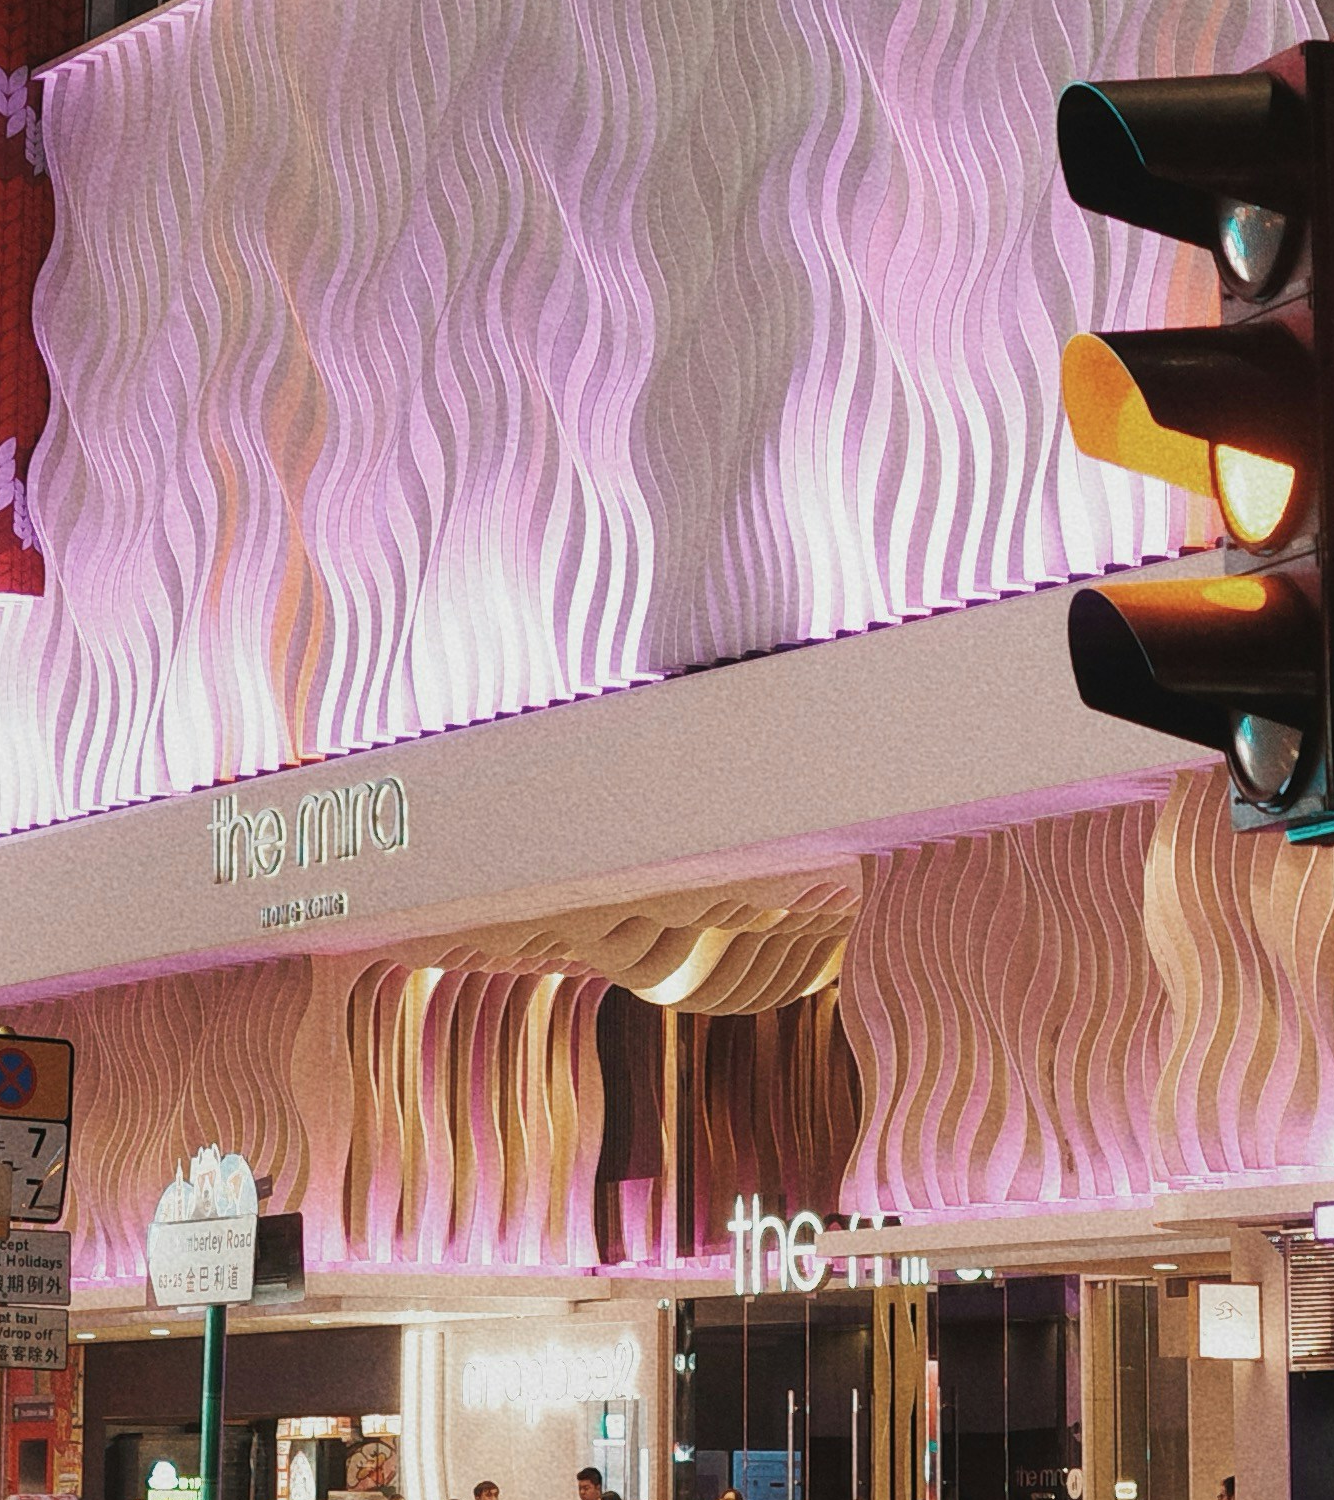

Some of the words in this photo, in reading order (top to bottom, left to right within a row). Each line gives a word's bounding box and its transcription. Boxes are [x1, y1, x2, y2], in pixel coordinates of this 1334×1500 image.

[207, 793, 286, 884] the
[296, 775, 410, 870] mira
[260, 902, 304, 928] HONG
[304, 892, 348, 919] KONG
[27, 1127, 47, 1159] 7
[25, 1178, 45, 1210] 7
[226, 1229, 252, 1250] Road
[727, 1193, 831, 1296] the
[6, 1254, 63, 1274] Holidays
[185, 1265, 239, 1293] 金巴利道
[15, 1311, 38, 1326] taxi
[35, 1328, 53, 1341] off
